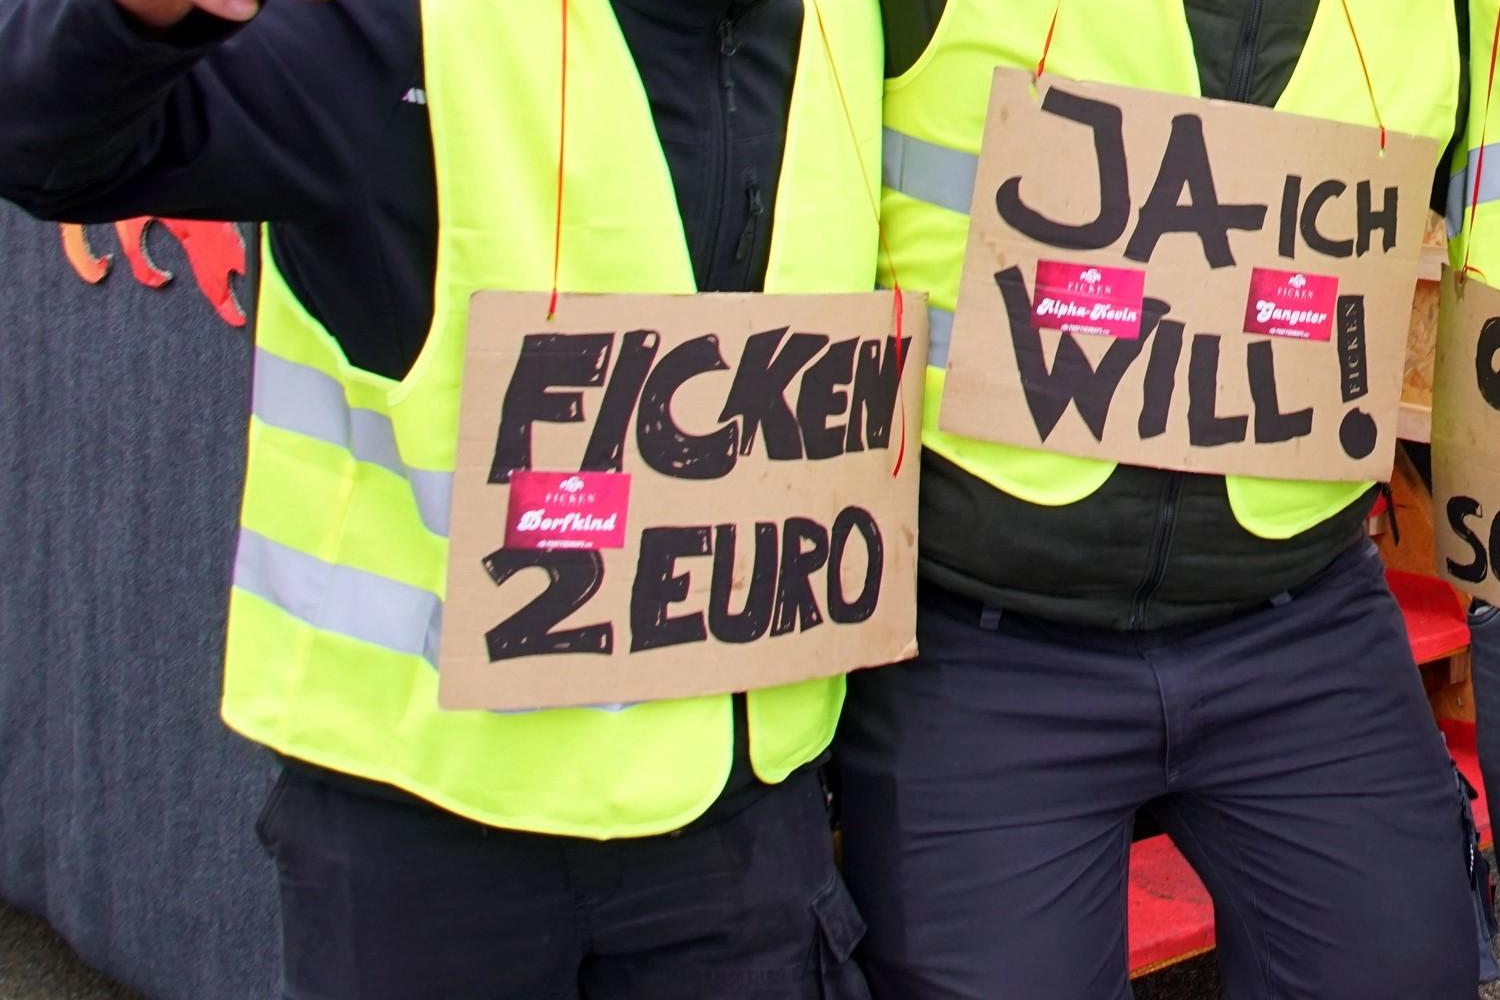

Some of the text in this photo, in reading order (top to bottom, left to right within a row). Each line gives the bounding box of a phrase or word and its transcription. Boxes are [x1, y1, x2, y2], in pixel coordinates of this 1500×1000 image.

[1278, 174, 1399, 259] ICH
[1036, 297, 1137, 323] Alpha-Kevin
[1067, 281, 1112, 296] FICKEN
[1255, 299, 1328, 326] Gangster
[1277, 286, 1314, 300] FICKEN
[994, 265, 1378, 460] WILL!
[1344, 302, 1361, 395] FICKEN
[487, 326, 913, 485] FICKEN
[517, 507, 618, 534] Dorfkind
[482, 506, 884, 663] 2 EURO
